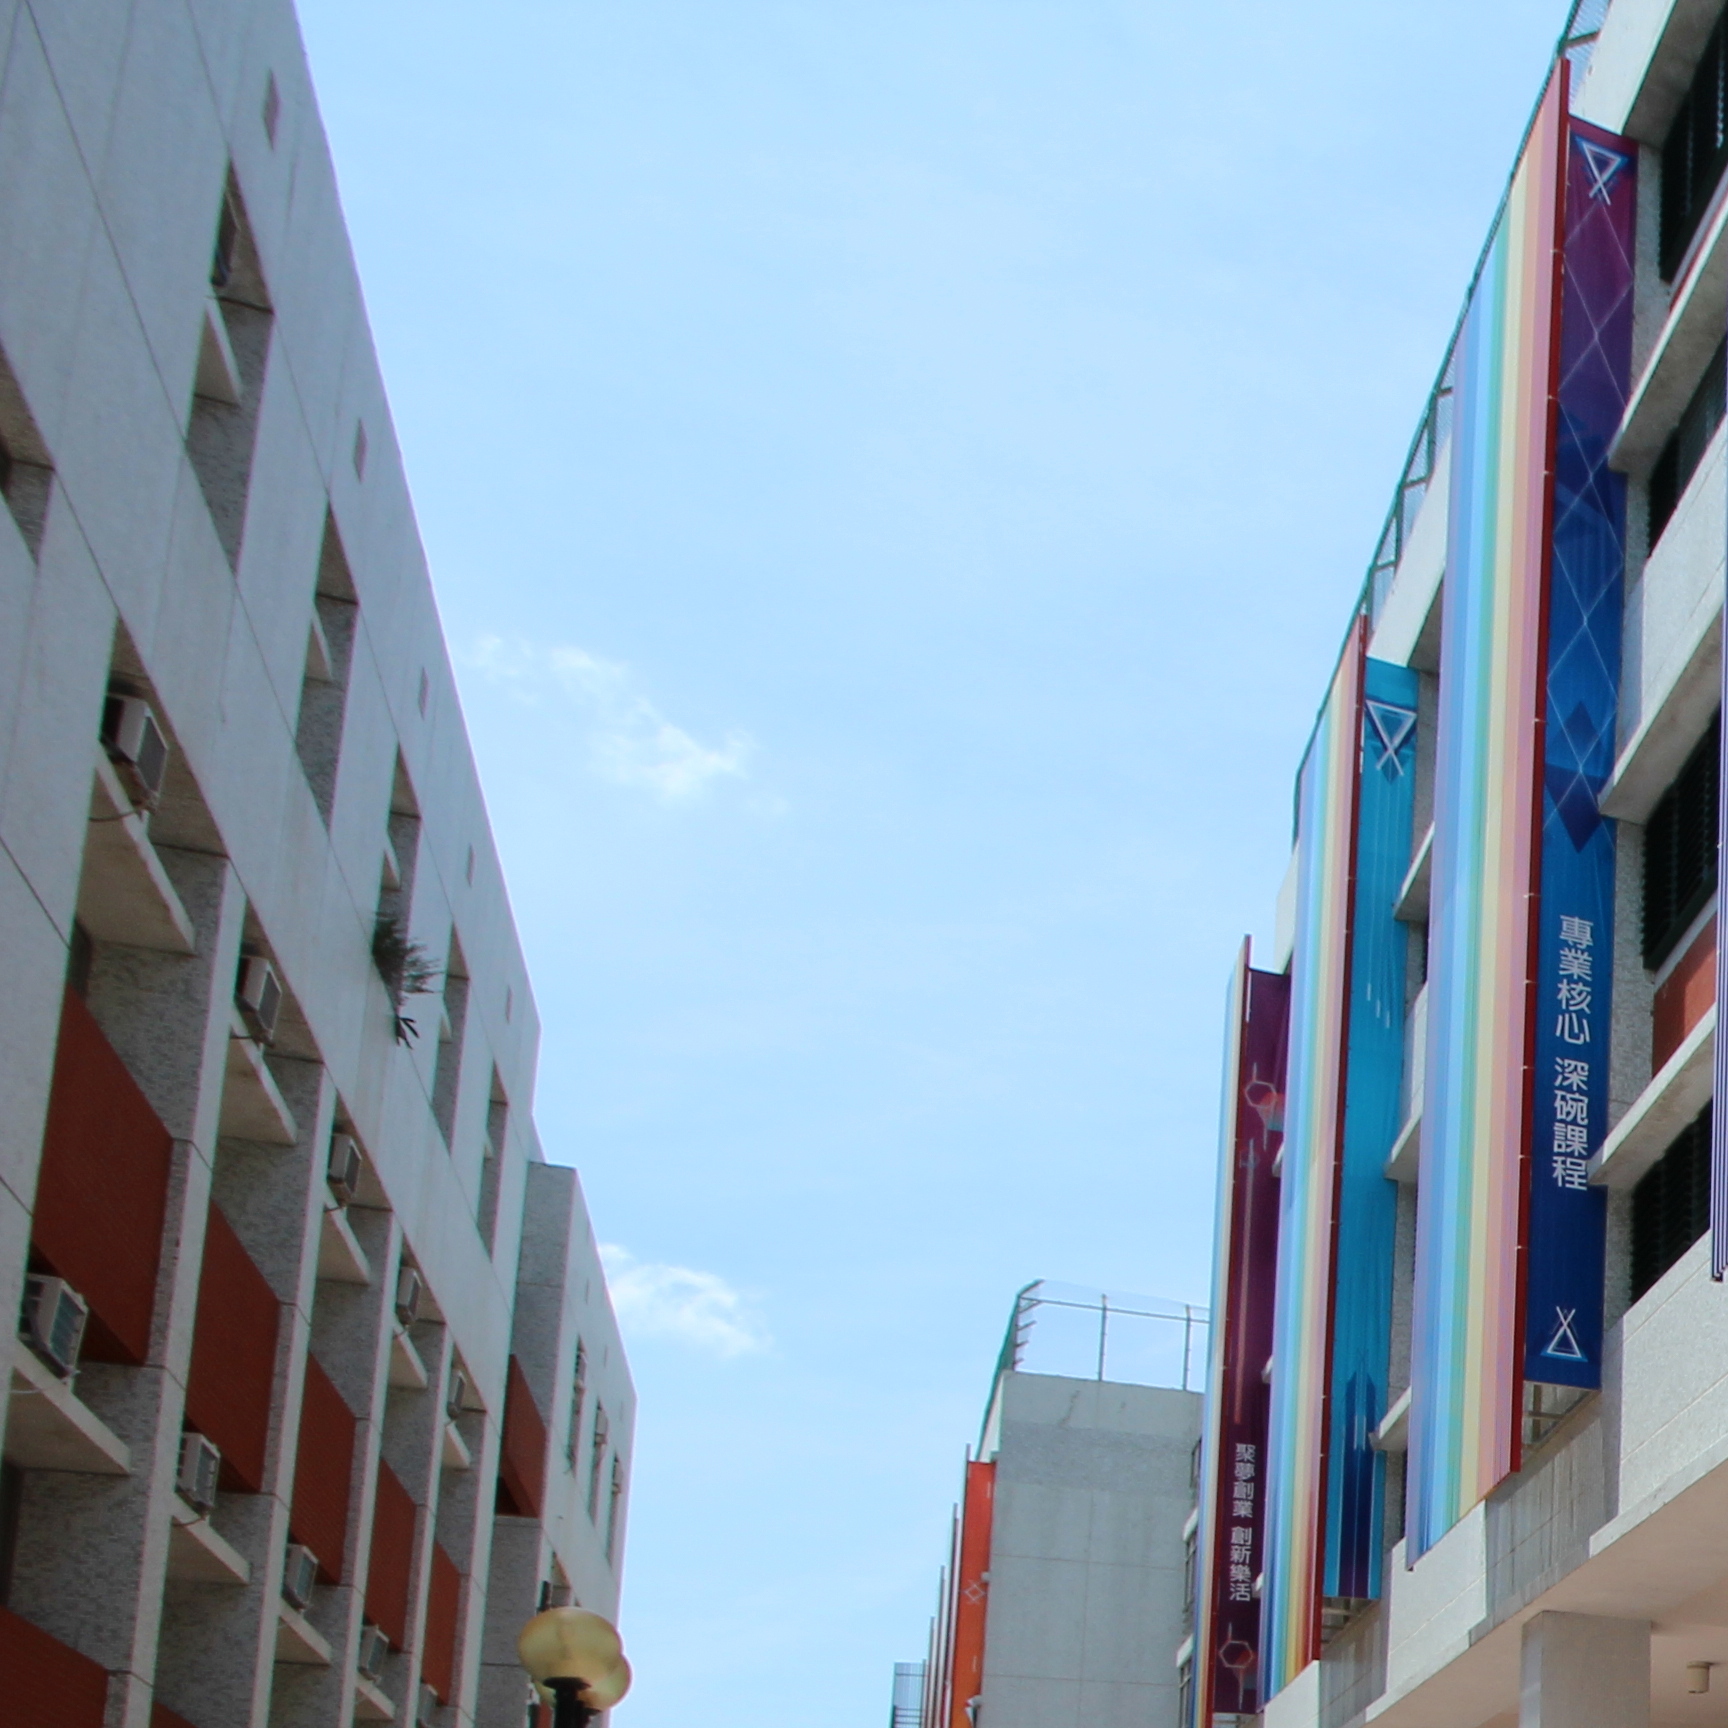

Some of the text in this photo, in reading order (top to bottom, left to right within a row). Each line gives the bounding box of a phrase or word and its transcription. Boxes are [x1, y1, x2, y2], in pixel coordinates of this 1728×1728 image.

[1552, 915, 1594, 1191] 專業核心 深碗課程
[1230, 1443, 1256, 1602] 聚夢創業 創新樂活
